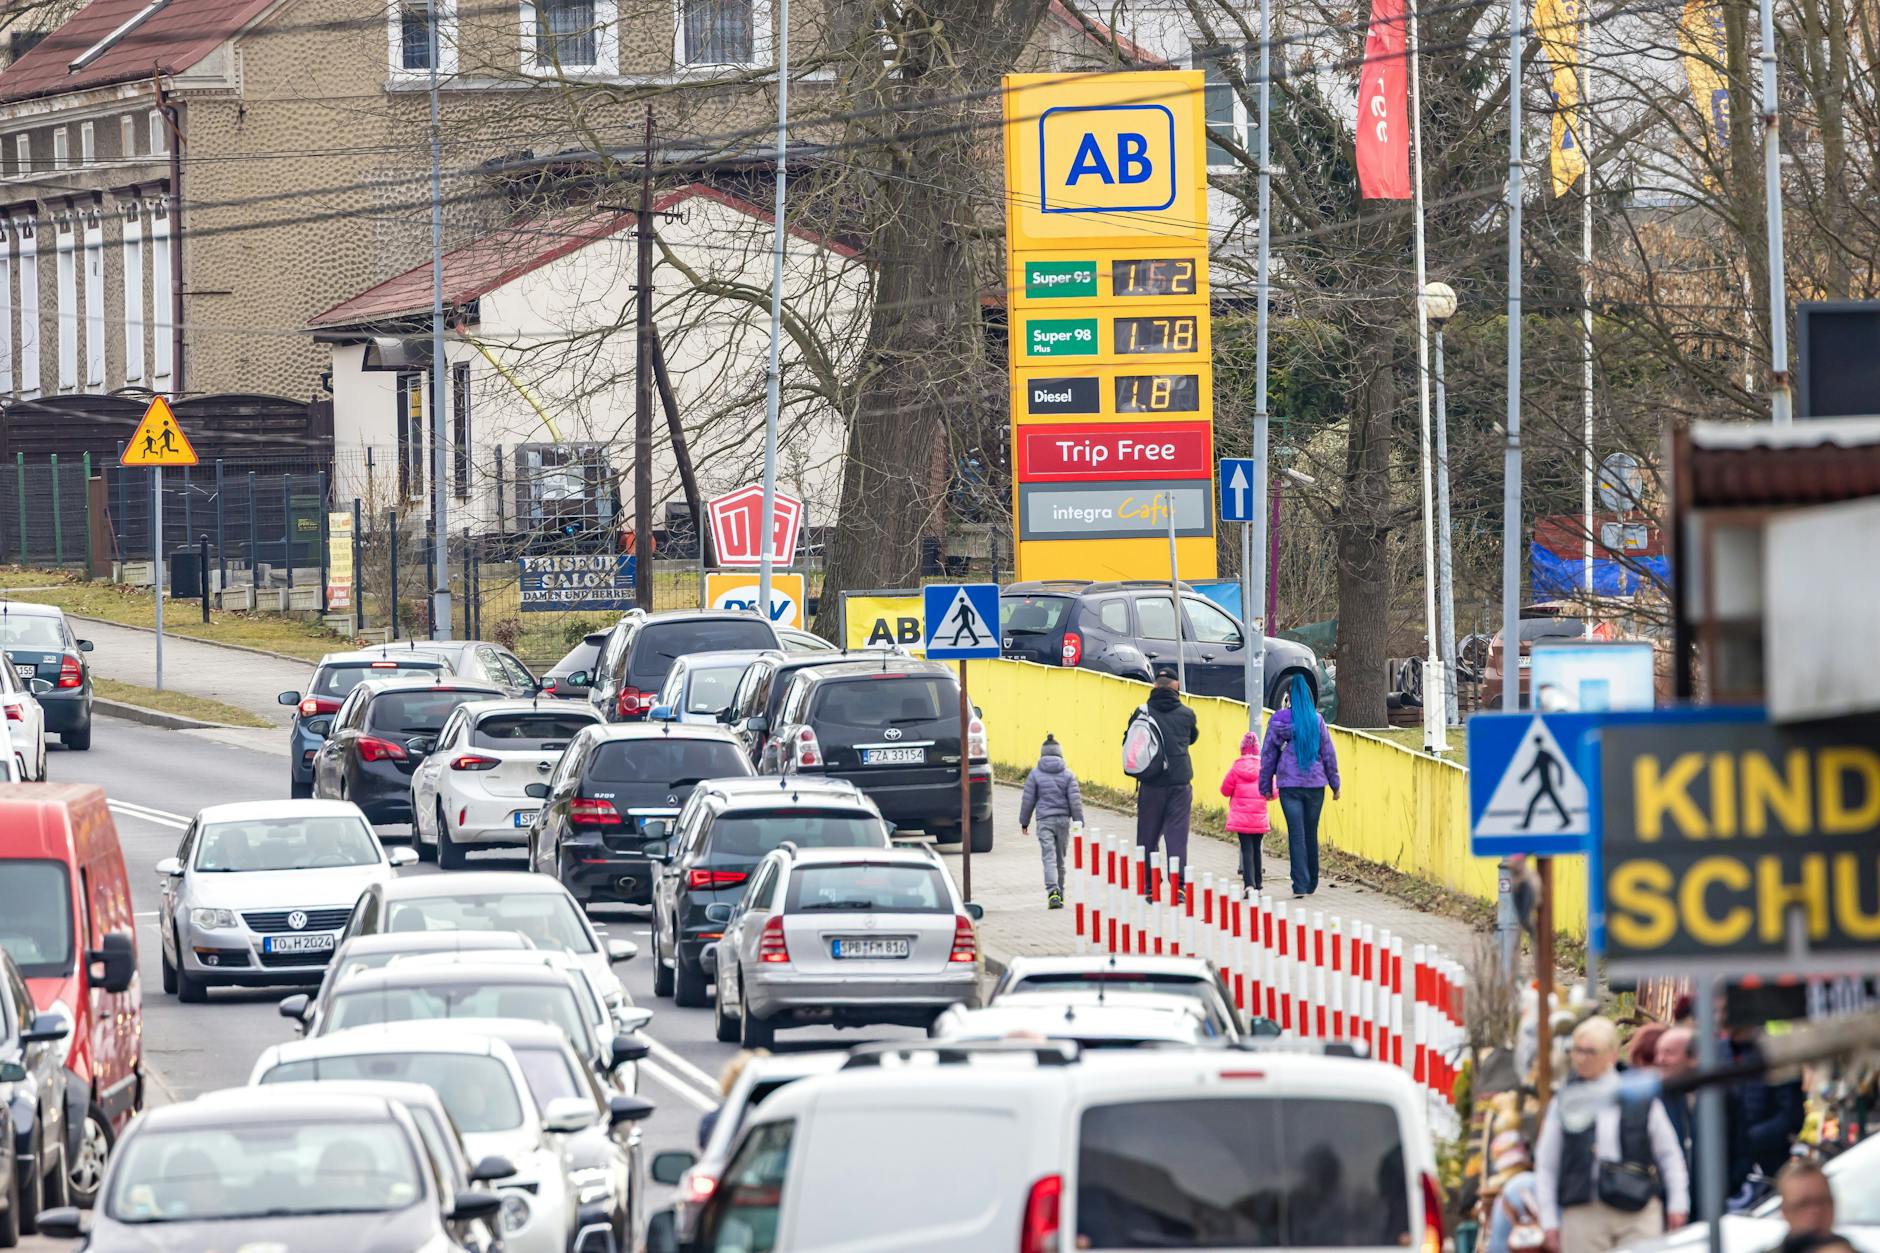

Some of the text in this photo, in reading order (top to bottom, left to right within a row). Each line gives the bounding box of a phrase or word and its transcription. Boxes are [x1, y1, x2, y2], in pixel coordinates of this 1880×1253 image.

[1065, 132, 1153, 186] AB
[1032, 271, 1091, 287] Super 95
[1033, 329, 1092, 344] Super 98
[1130, 319, 1194, 351] 1.78
[1033, 344, 1051, 353] Plus
[1034, 388, 1072, 403] Diesel
[1055, 439, 1176, 467] Trip Free
[1053, 504, 1113, 523] integra
[524, 556, 618, 572] FRISEUR
[541, 572, 616, 589] SALON
[565, 590, 589, 600] UND
[867, 616, 926, 646] AB
[868, 748, 923, 762] FZA 33154
[1633, 748, 1880, 842] KIND
[522, 813, 540, 824] SP
[1608, 853, 1880, 947] SCHU
[304, 936, 331, 949] 2024
